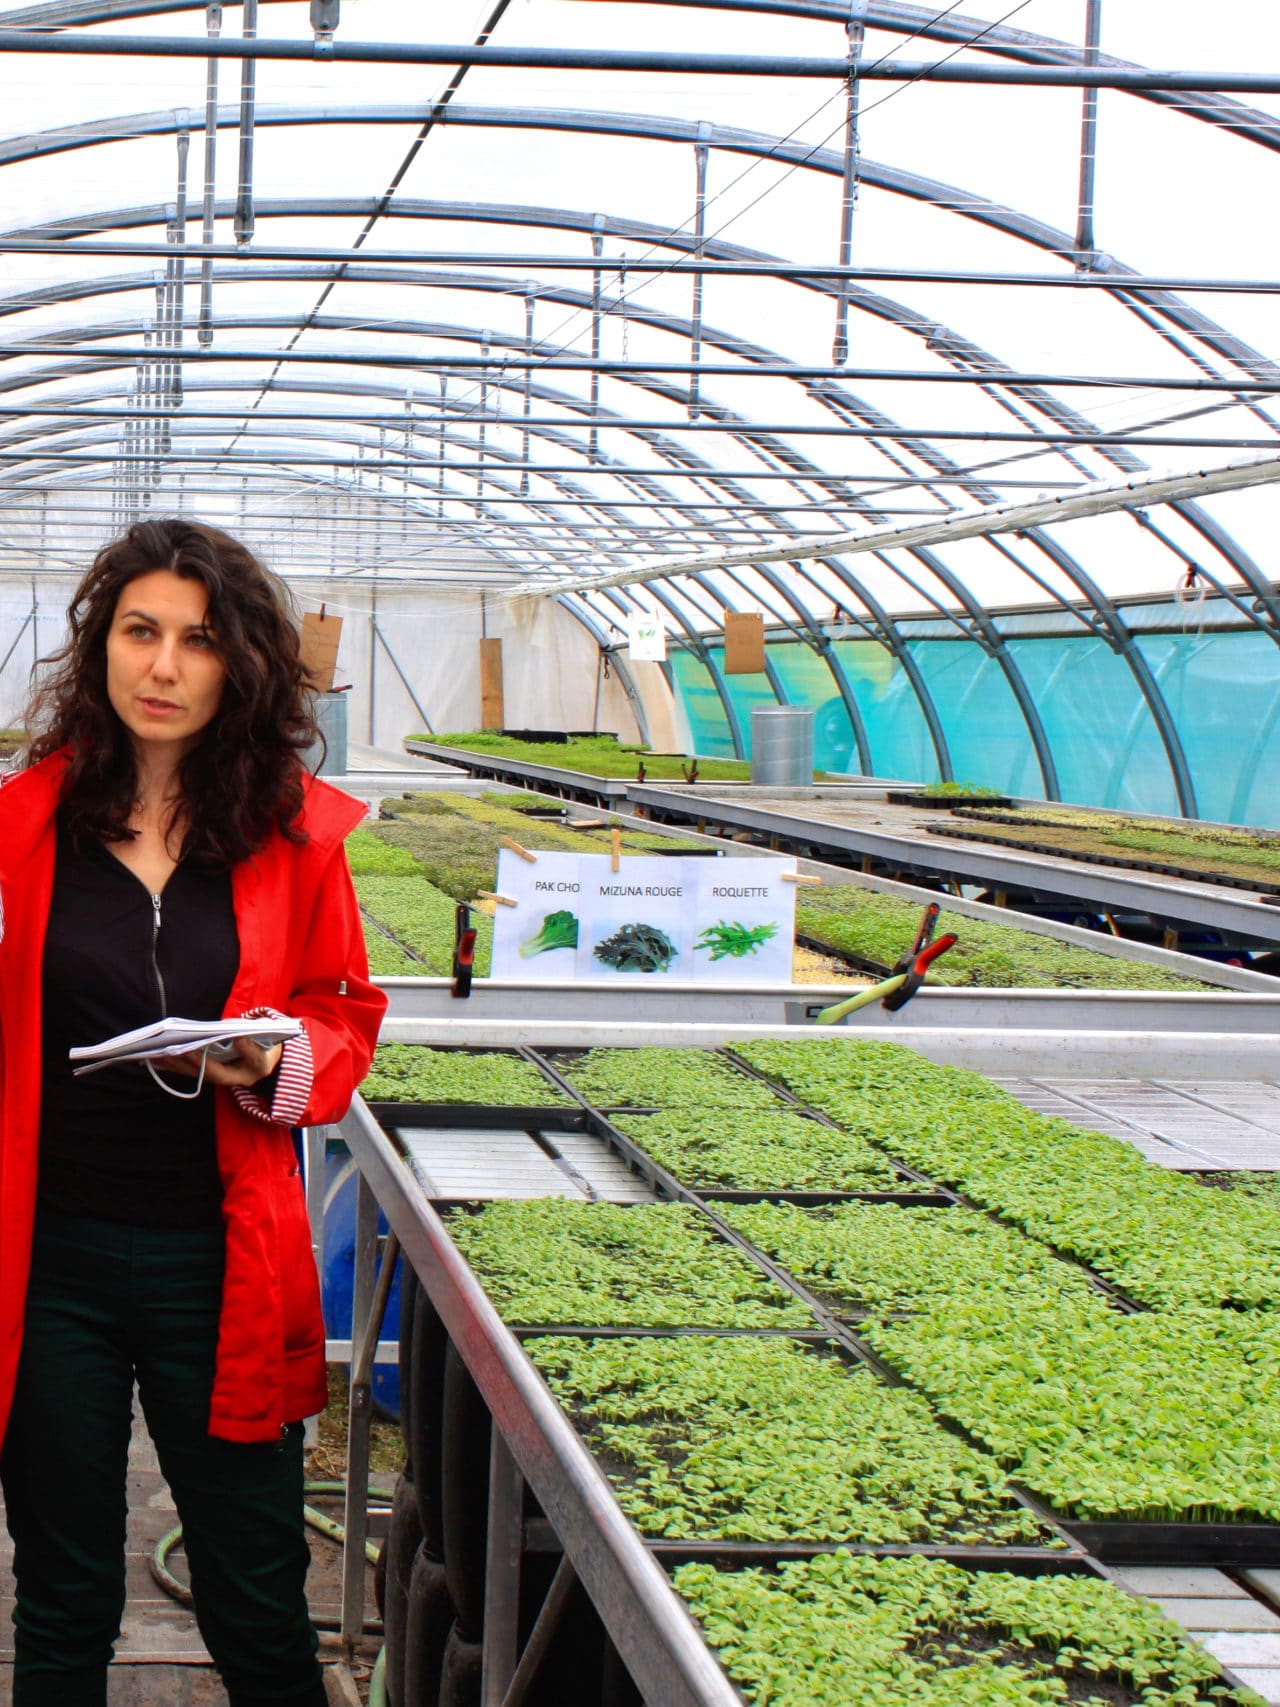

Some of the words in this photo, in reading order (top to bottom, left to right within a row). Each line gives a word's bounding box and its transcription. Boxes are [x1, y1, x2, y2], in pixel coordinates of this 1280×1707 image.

[535, 881, 554, 892] PAK
[599, 886, 642, 896] MIZUNA
[645, 887, 683, 897] ROUGE
[712, 887, 768, 897] ROQUETTE
